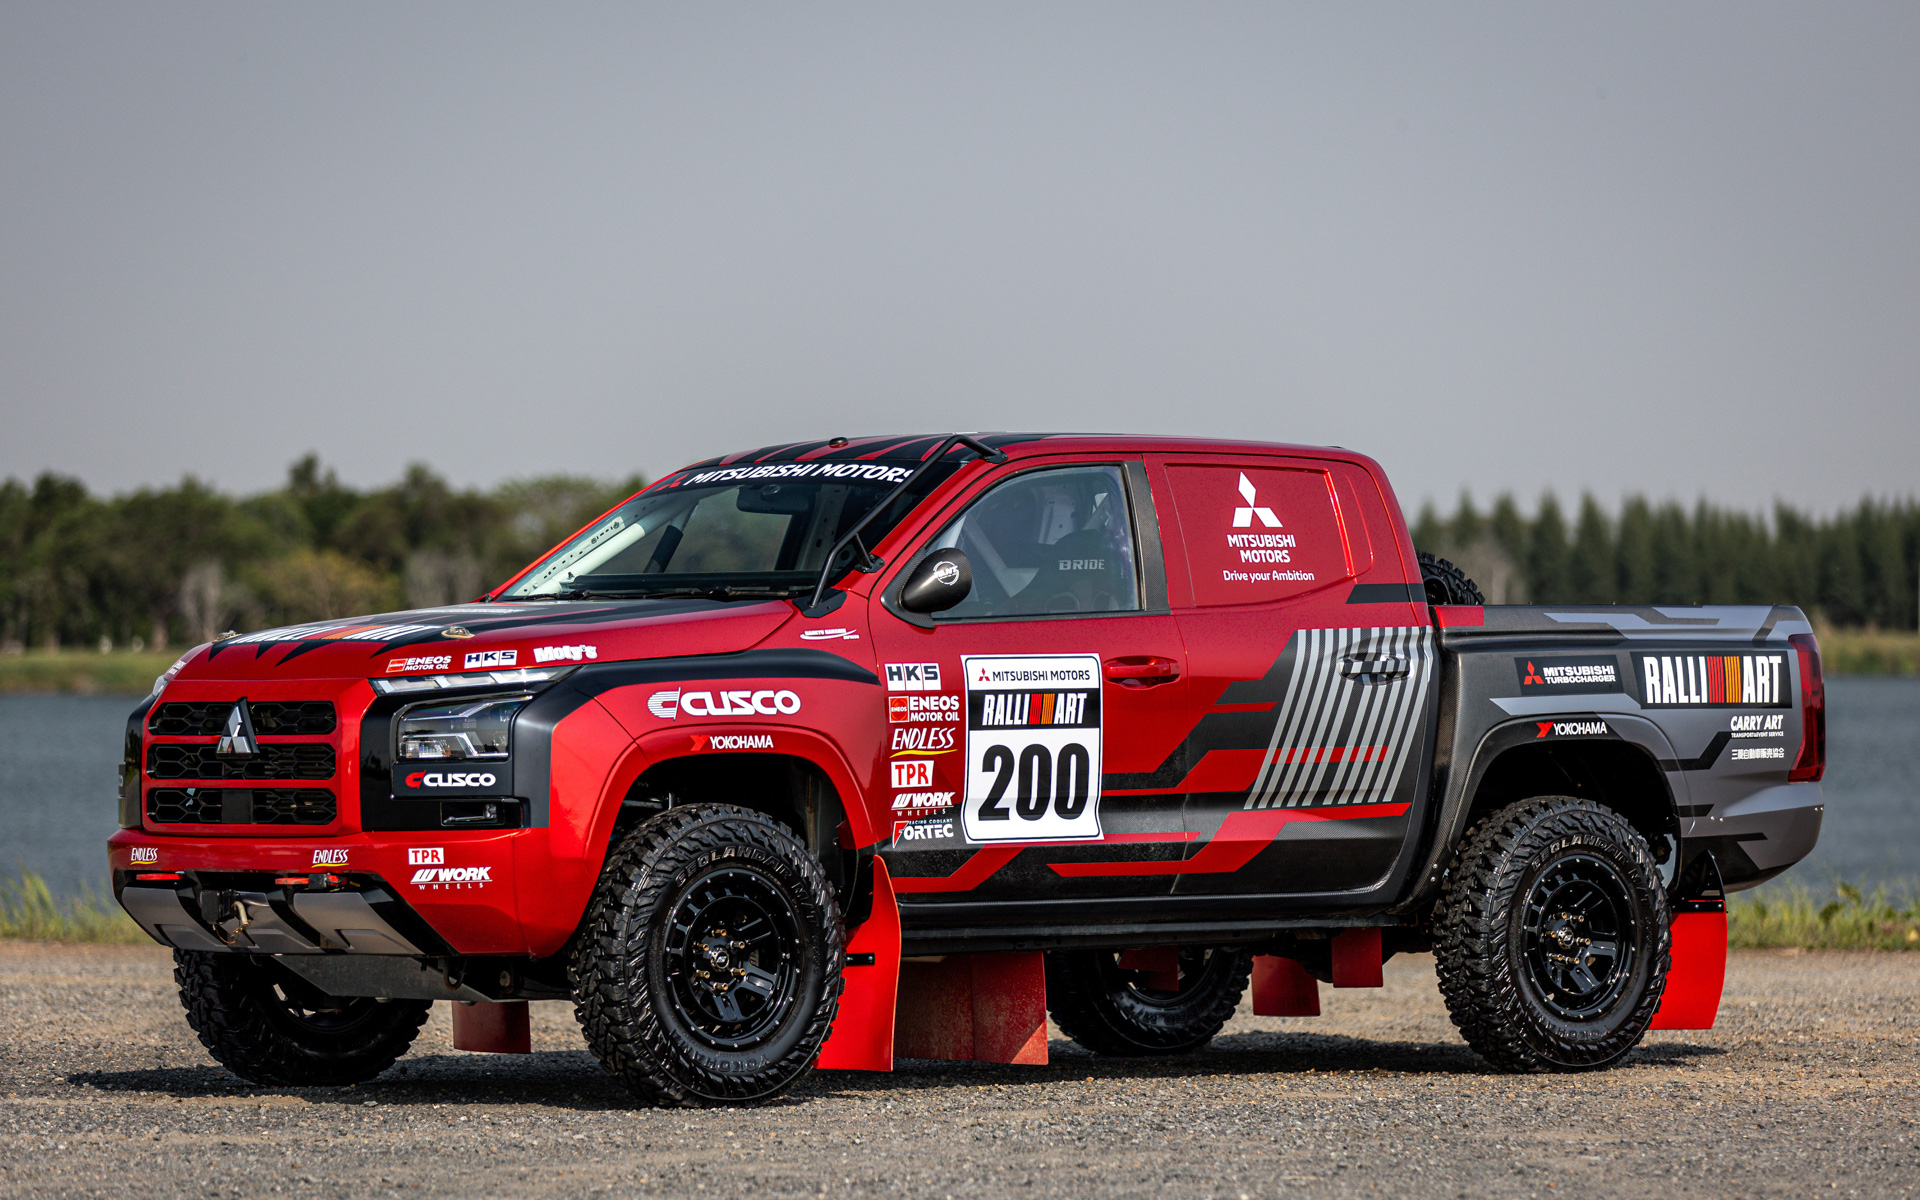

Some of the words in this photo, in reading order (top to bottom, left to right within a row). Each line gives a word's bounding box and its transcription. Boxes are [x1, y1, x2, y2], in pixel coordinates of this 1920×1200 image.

[683, 464, 818, 486] MITSUBISHI
[1227, 534, 1296, 548] MITSUBISHI
[1240, 550, 1291, 563] MOTORS
[1059, 559, 1105, 571] BRIDE
[1222, 570, 1249, 581] Drive
[1249, 572, 1270, 584] your
[1272, 570, 1315, 581] Ambition
[406, 655, 452, 666] ENEOS
[466, 651, 516, 663] HKS
[533, 645, 598, 663] Moty's
[887, 665, 939, 682] HKS
[992, 671, 1048, 682] MITSUBISHI
[1050, 670, 1091, 681] MOTORS
[1543, 665, 1615, 677] MITSUBISHI
[1545, 674, 1616, 684] TURBOCHARGER
[909, 695, 960, 711] ENEOS
[910, 712, 944, 722] MOTOR
[945, 711, 960, 722] OIL
[1730, 714, 1764, 731] CARRY
[1764, 714, 1784, 730] ART
[1553, 721, 1608, 736] YOKOHAMA
[709, 734, 774, 750] YOKOHAMA
[891, 726, 957, 750] ENDLESS
[895, 762, 929, 786] TPR
[978, 742, 1091, 822] 200
[912, 791, 956, 808] WORK
[896, 808, 946, 817] WHEELS
[130, 847, 159, 861] ENDLESS
[312, 849, 349, 864] ENDLESS
[411, 849, 441, 863] TPR
[438, 866, 492, 881] WORK
[419, 882, 484, 891] WHEELS
